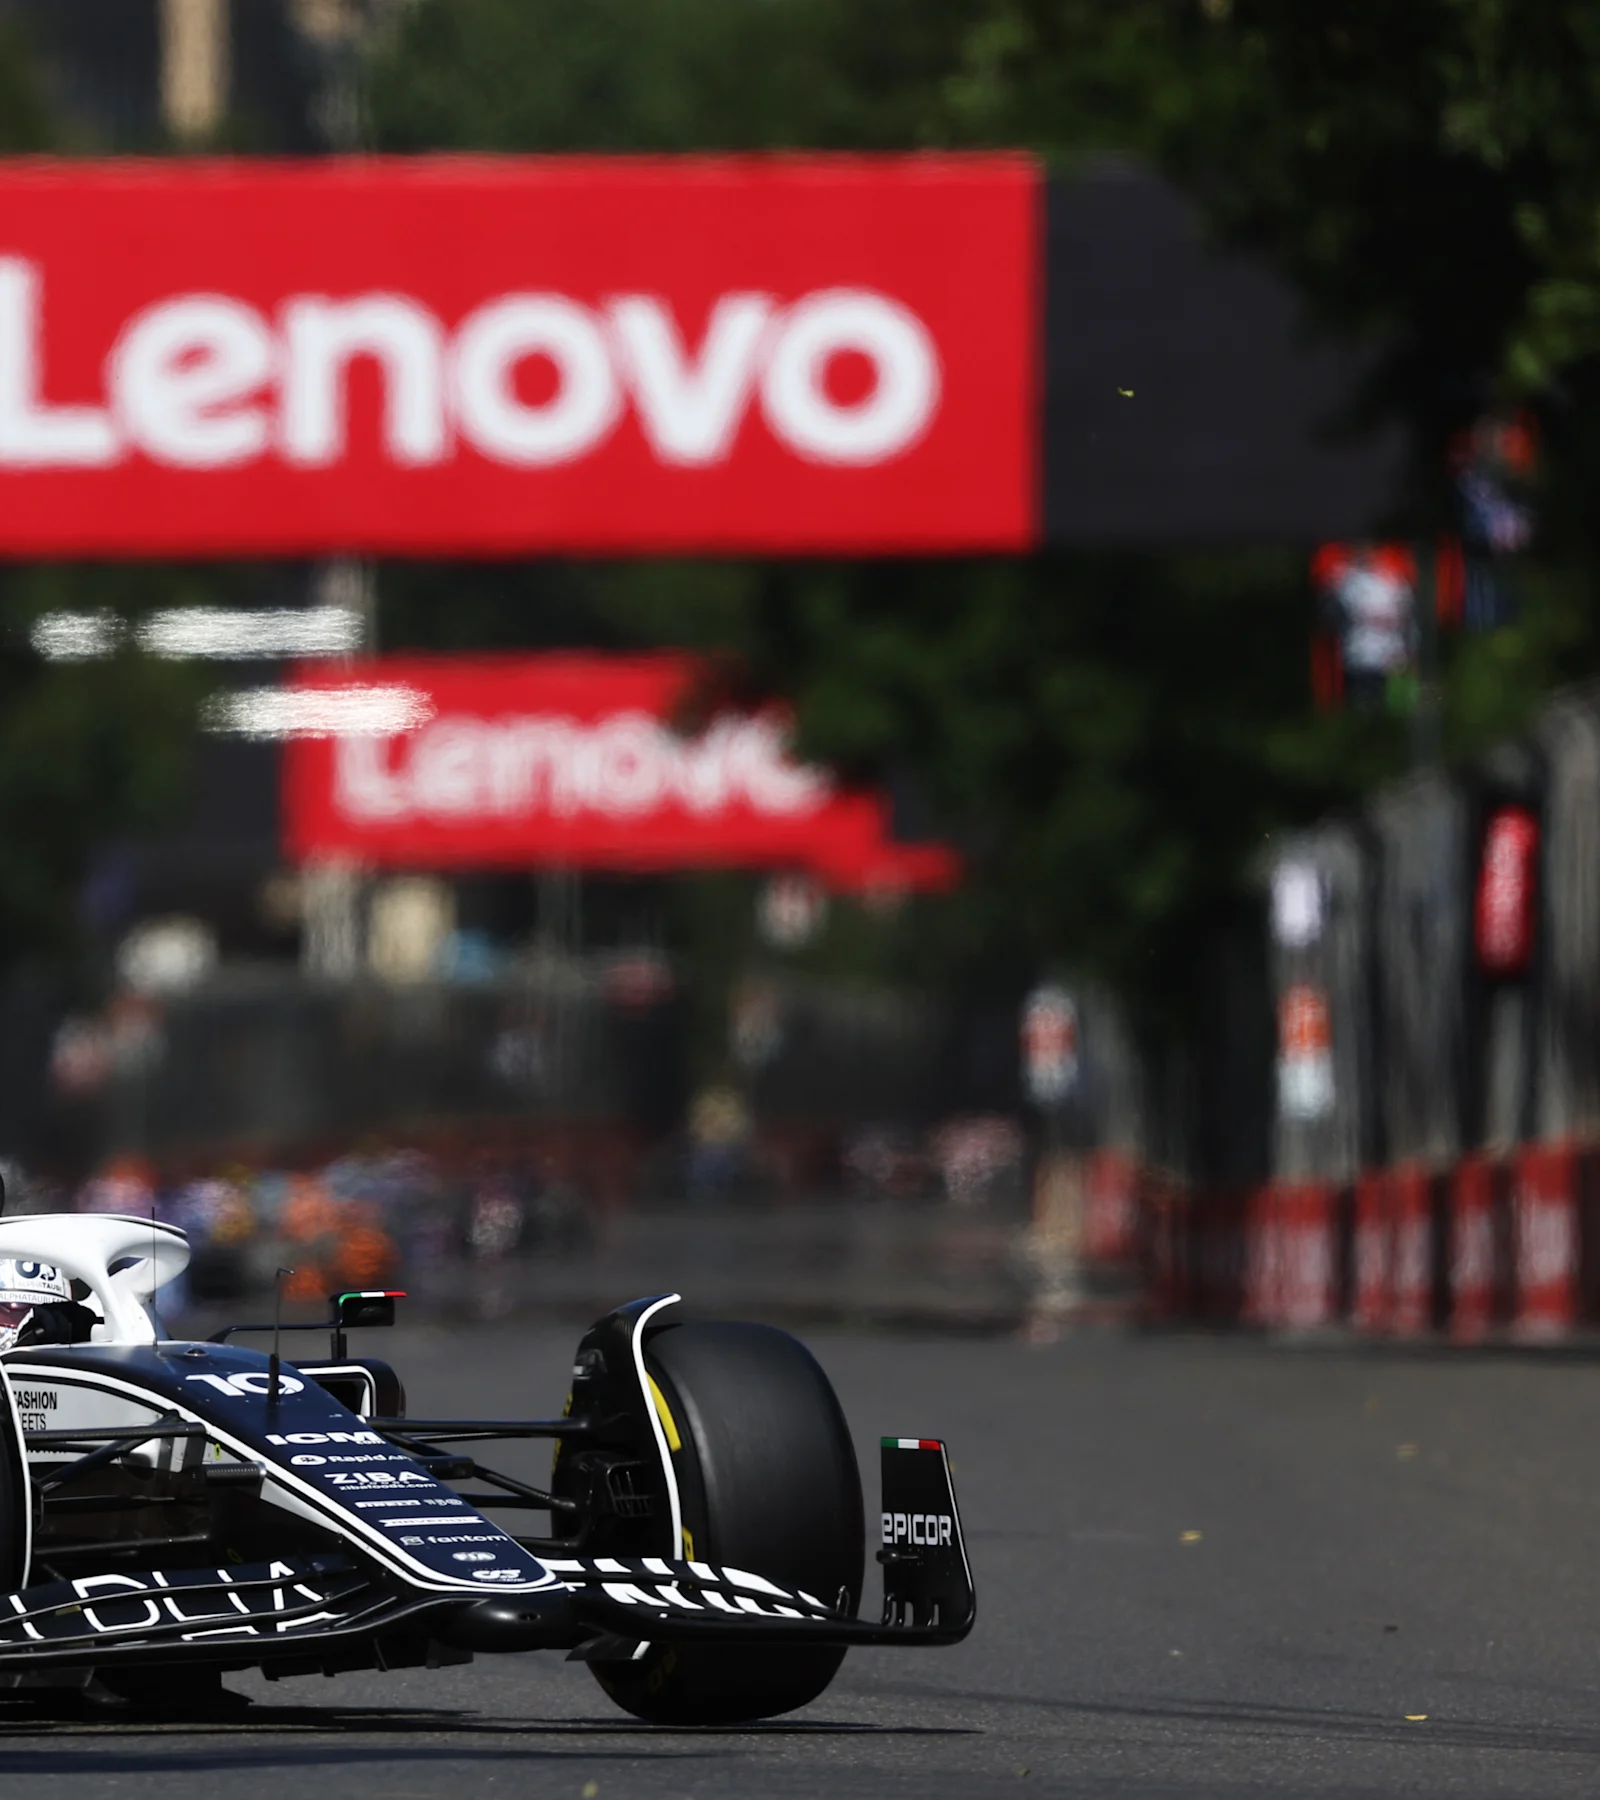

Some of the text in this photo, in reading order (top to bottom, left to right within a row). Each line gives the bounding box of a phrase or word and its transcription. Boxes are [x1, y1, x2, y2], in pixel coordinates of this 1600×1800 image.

[186, 1373, 304, 1396] 10
[13, 1391, 57, 1410] ASHION
[19, 1412, 46, 1430] EETS
[265, 1432, 380, 1446] ICM
[324, 1471, 430, 1484] ZIBA
[339, 1482, 437, 1490] zibafoods.com
[427, 1535, 508, 1544] fantom
